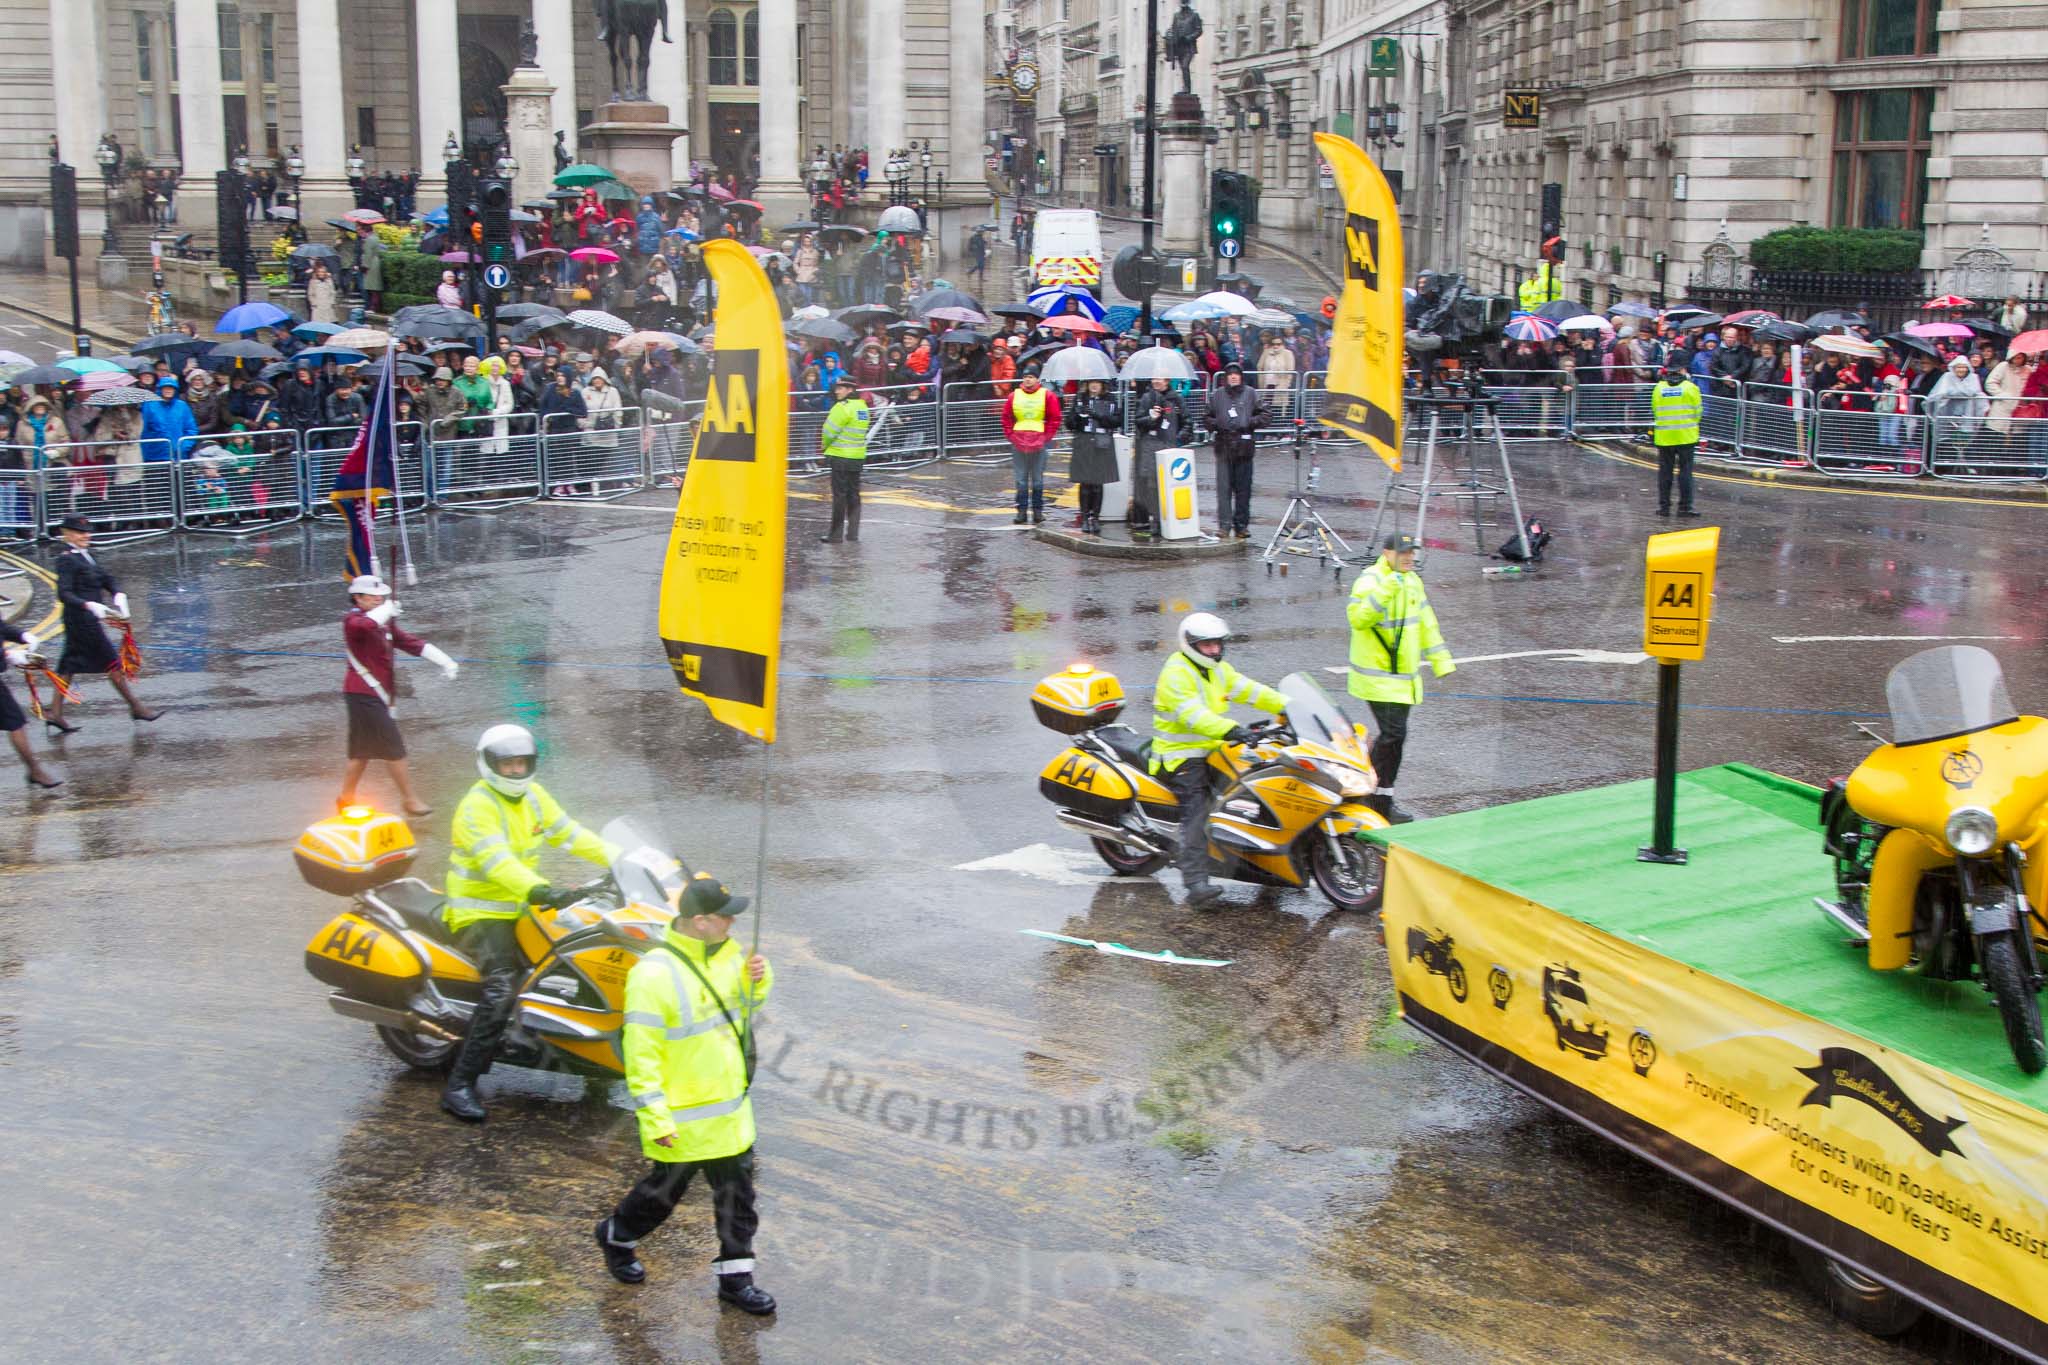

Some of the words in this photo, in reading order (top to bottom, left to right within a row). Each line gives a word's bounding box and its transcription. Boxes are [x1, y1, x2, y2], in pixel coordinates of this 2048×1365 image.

[1346, 226, 1377, 273] AA
[702, 374, 755, 434] AA
[1657, 583, 1693, 608] AA
[1652, 624, 1698, 636] Service
[1055, 753, 1100, 791] AA
[321, 920, 381, 966] AA
[1684, 1072, 1759, 1125] Providing
[1763, 1107, 1848, 1165] Londoners
[1852, 1152, 1892, 1187] with
[1897, 1172, 1983, 1229] Roadside
[1789, 1150, 1815, 1177] for
[1819, 1167, 1859, 1197] over
[1866, 1186, 1895, 1215] 100
[1900, 1202, 1951, 1242] Years
